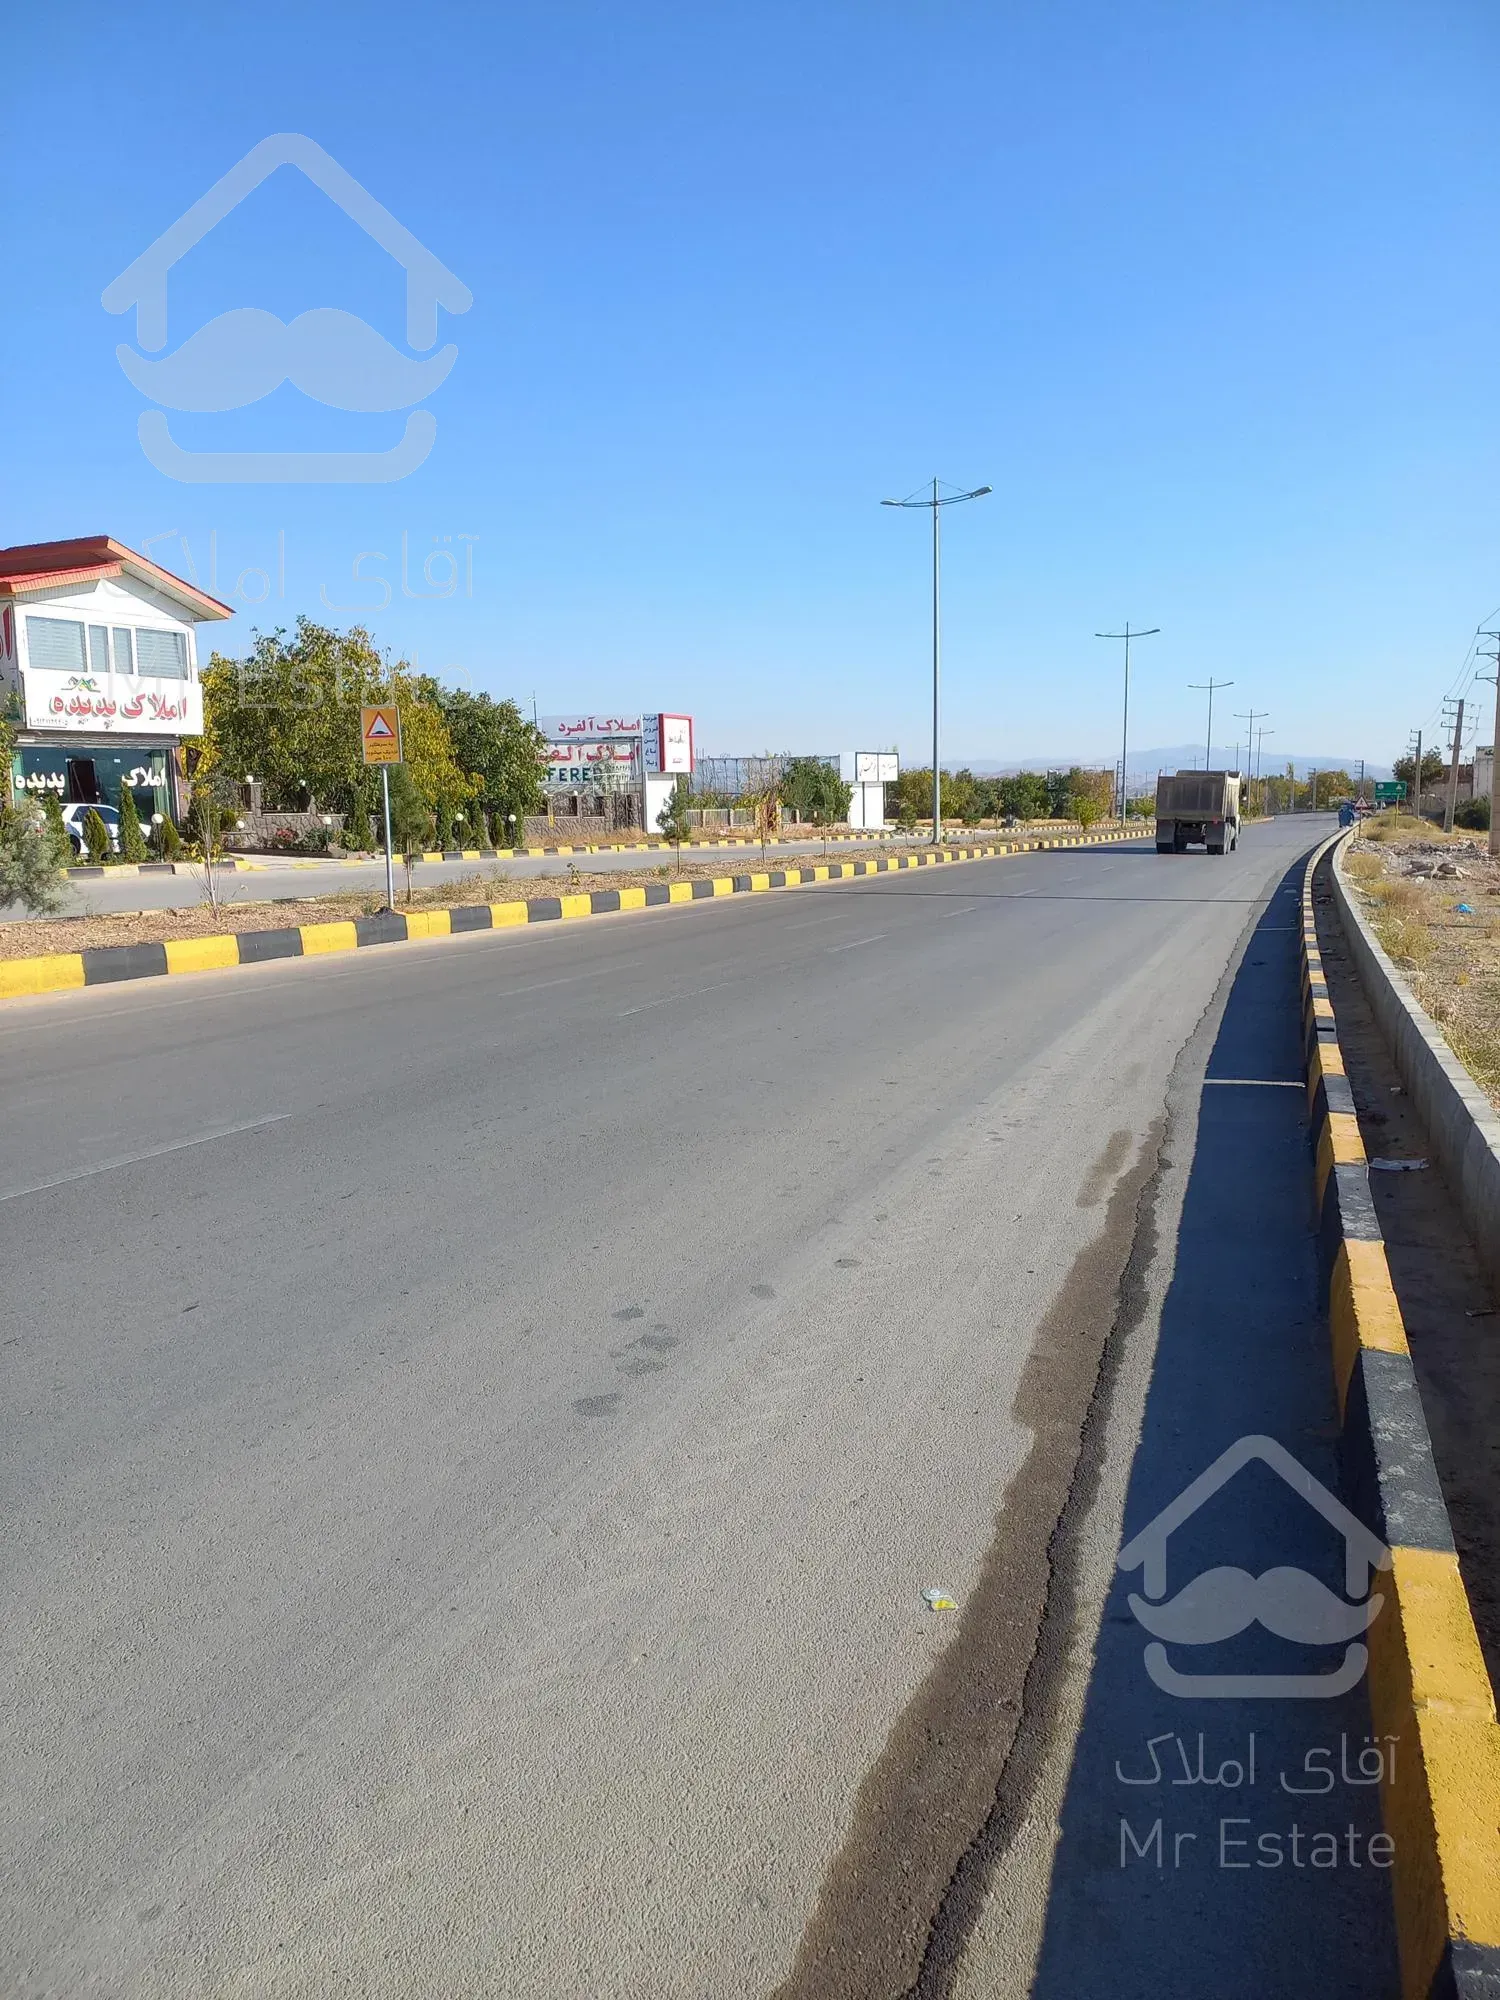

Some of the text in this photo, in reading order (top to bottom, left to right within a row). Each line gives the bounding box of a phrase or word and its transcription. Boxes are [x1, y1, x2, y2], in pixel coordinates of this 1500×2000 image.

[121, 692, 187, 719] املاک
[558, 716, 640, 736] املاک آلفرد
[14, 765, 167, 796] املاک پدیده
